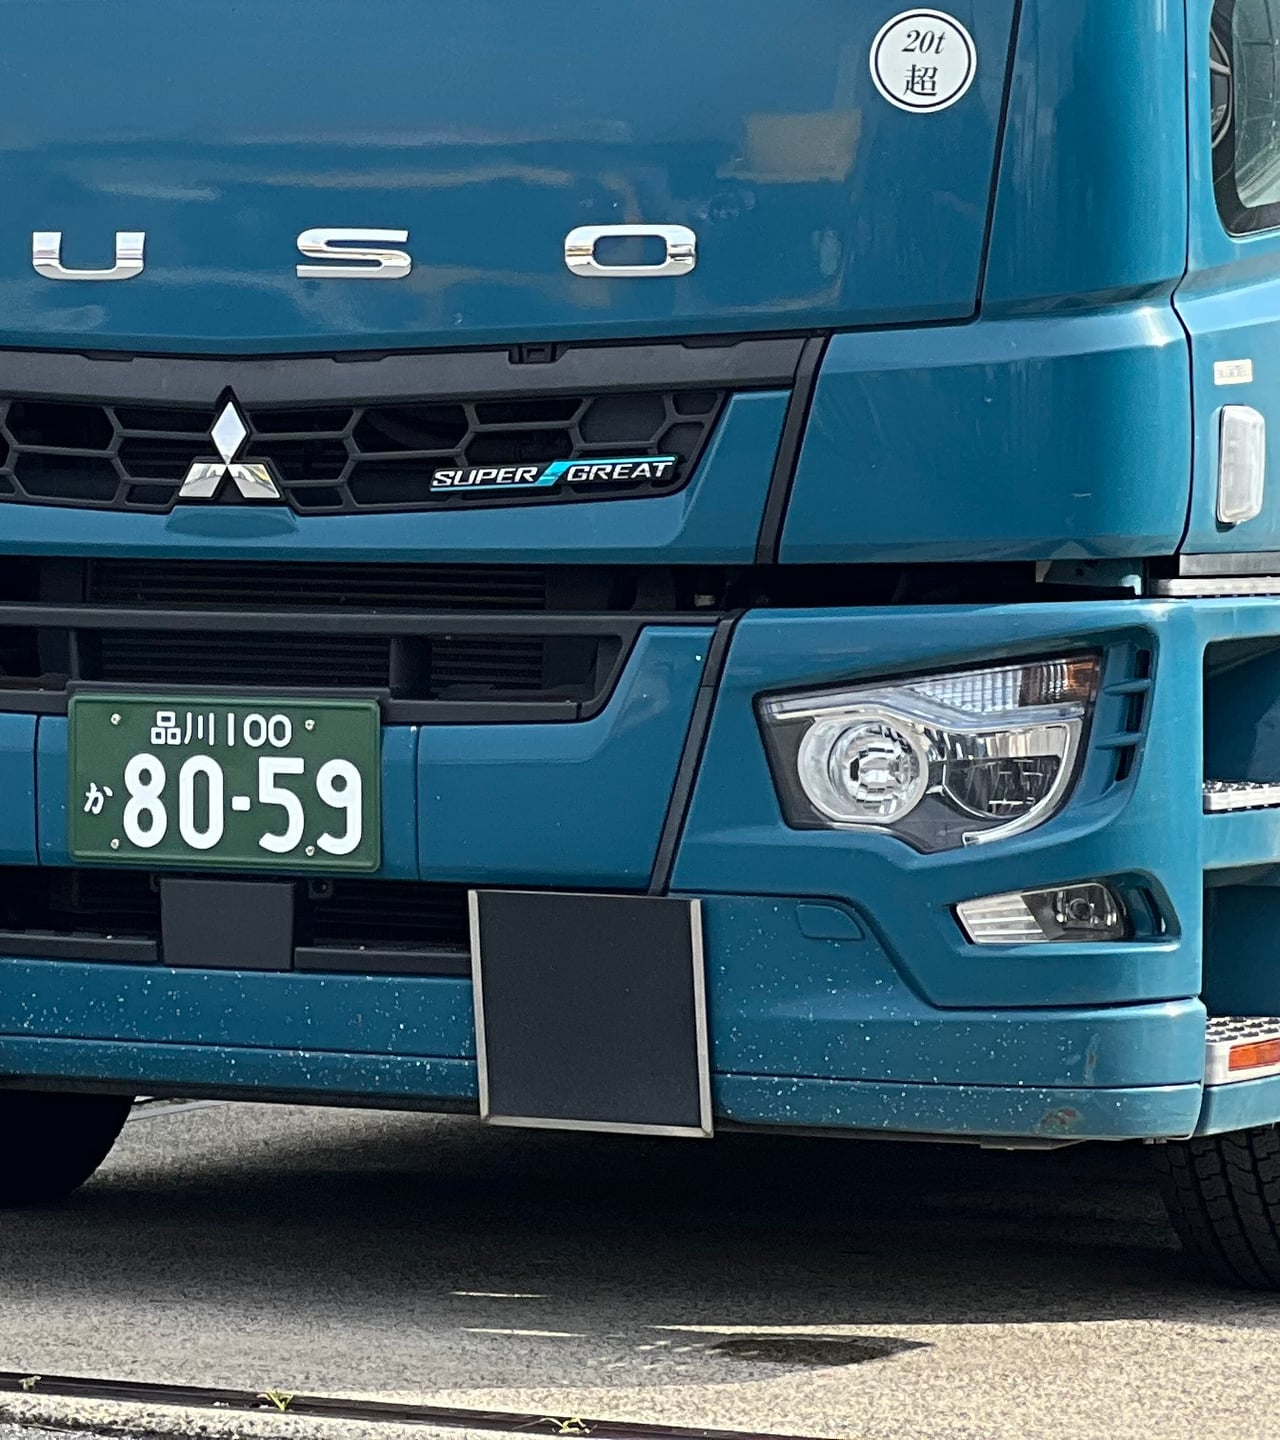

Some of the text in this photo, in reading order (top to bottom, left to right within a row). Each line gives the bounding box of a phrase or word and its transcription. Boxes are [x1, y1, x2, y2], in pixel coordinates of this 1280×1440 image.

[903, 64, 939, 97] 超
[432, 462, 673, 487] SUPER GREAT
[150, 710, 292, 749] 品川 100
[83, 752, 363, 856] か 80-59
